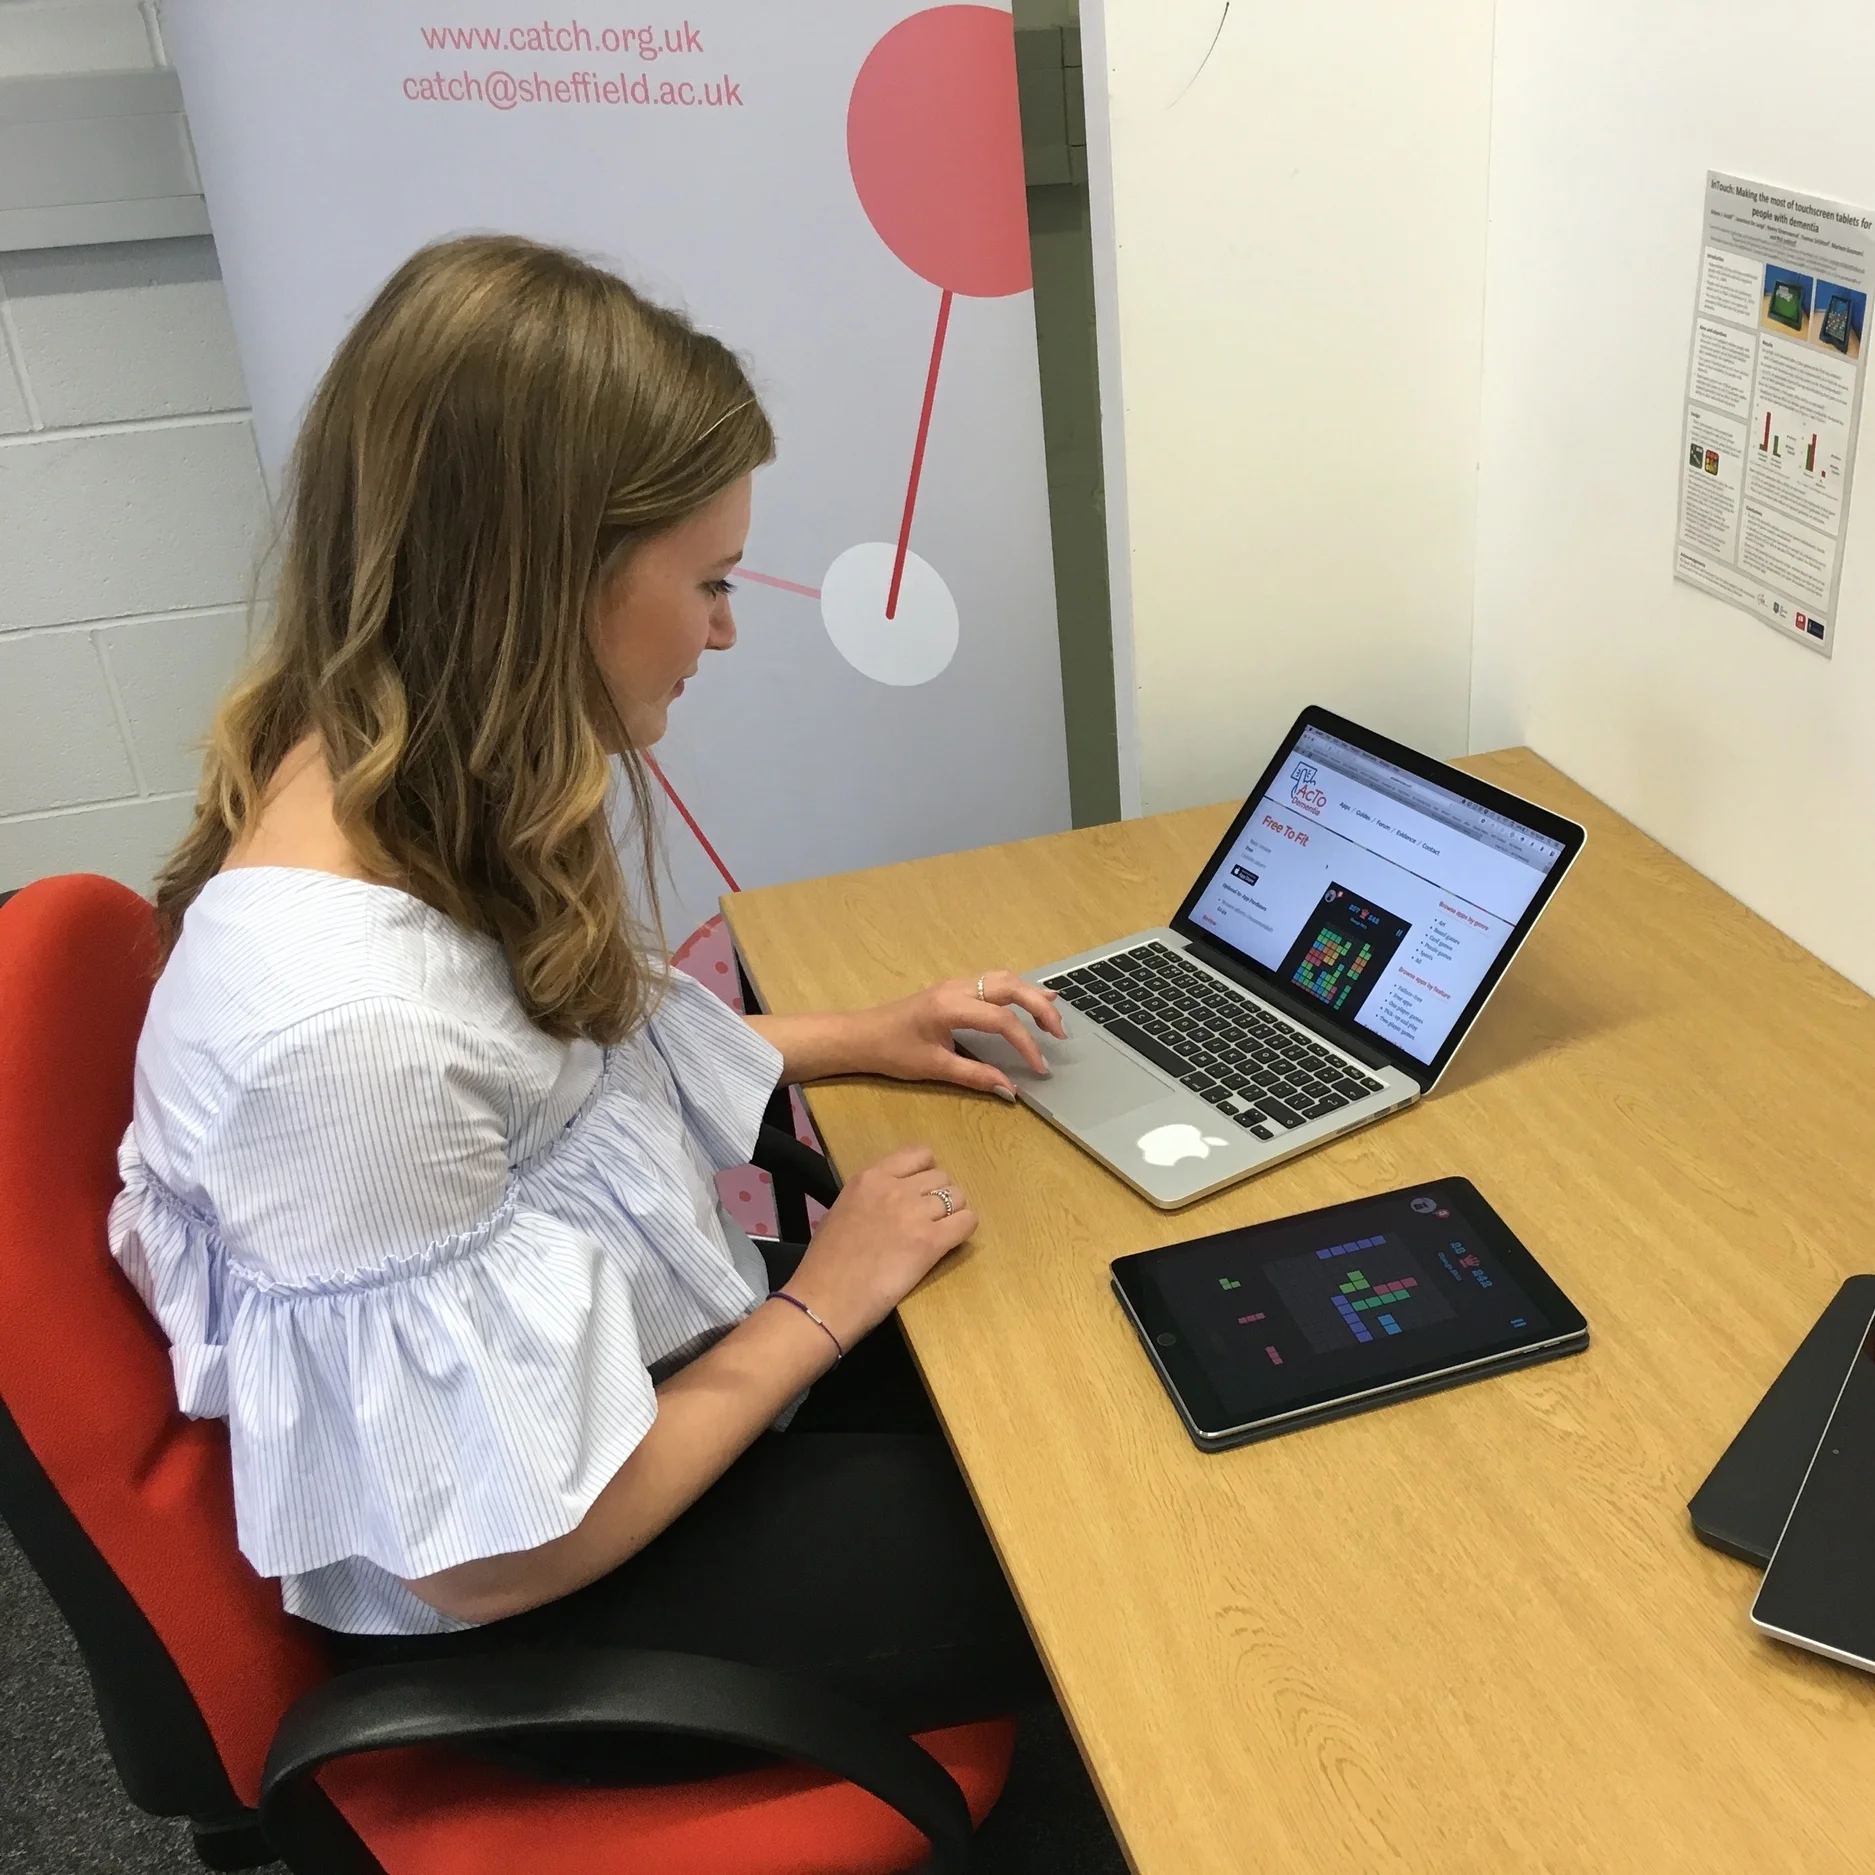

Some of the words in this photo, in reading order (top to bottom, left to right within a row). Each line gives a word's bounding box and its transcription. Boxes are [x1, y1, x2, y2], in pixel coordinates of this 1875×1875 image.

[420, 20, 704, 61] www.catch.org.uk
[403, 70, 744, 110] catch@sheffield.ac.uk
[1736, 186, 1757, 202] Making
[1759, 192, 1769, 203] the
[1770, 196, 1786, 208] most
[1787, 200, 1795, 210] of
[1795, 202, 1835, 220] touchscreen
[1836, 212, 1859, 227] tablets
[1861, 218, 1872, 230] for
[1752, 207, 1772, 220] people
[1774, 213, 1788, 225] with
[1789, 217, 1819, 233] dementia
[1291, 797, 1321, 816] Dementia
[1297, 784, 1327, 808] AcTo
[1262, 815, 1283, 833] Free
[1284, 825, 1295, 839] To
[1295, 831, 1310, 848] Fit
[1339, 801, 1350, 812] Apps
[1356, 810, 1371, 821] Guides
[1376, 820, 1391, 831] Forum
[1396, 830, 1416, 844] Evidence
[1422, 842, 1441, 856] Contact
[1438, 901, 1456, 914] Browse
[1456, 909, 1467, 920] apps
[1468, 916, 1474, 924] by
[1473, 920, 1489, 932] genre
[1398, 966, 1416, 980] Browse
[1415, 976, 1427, 987] apps
[1427, 982, 1434, 990] by
[1433, 985, 1451, 1000] feature
